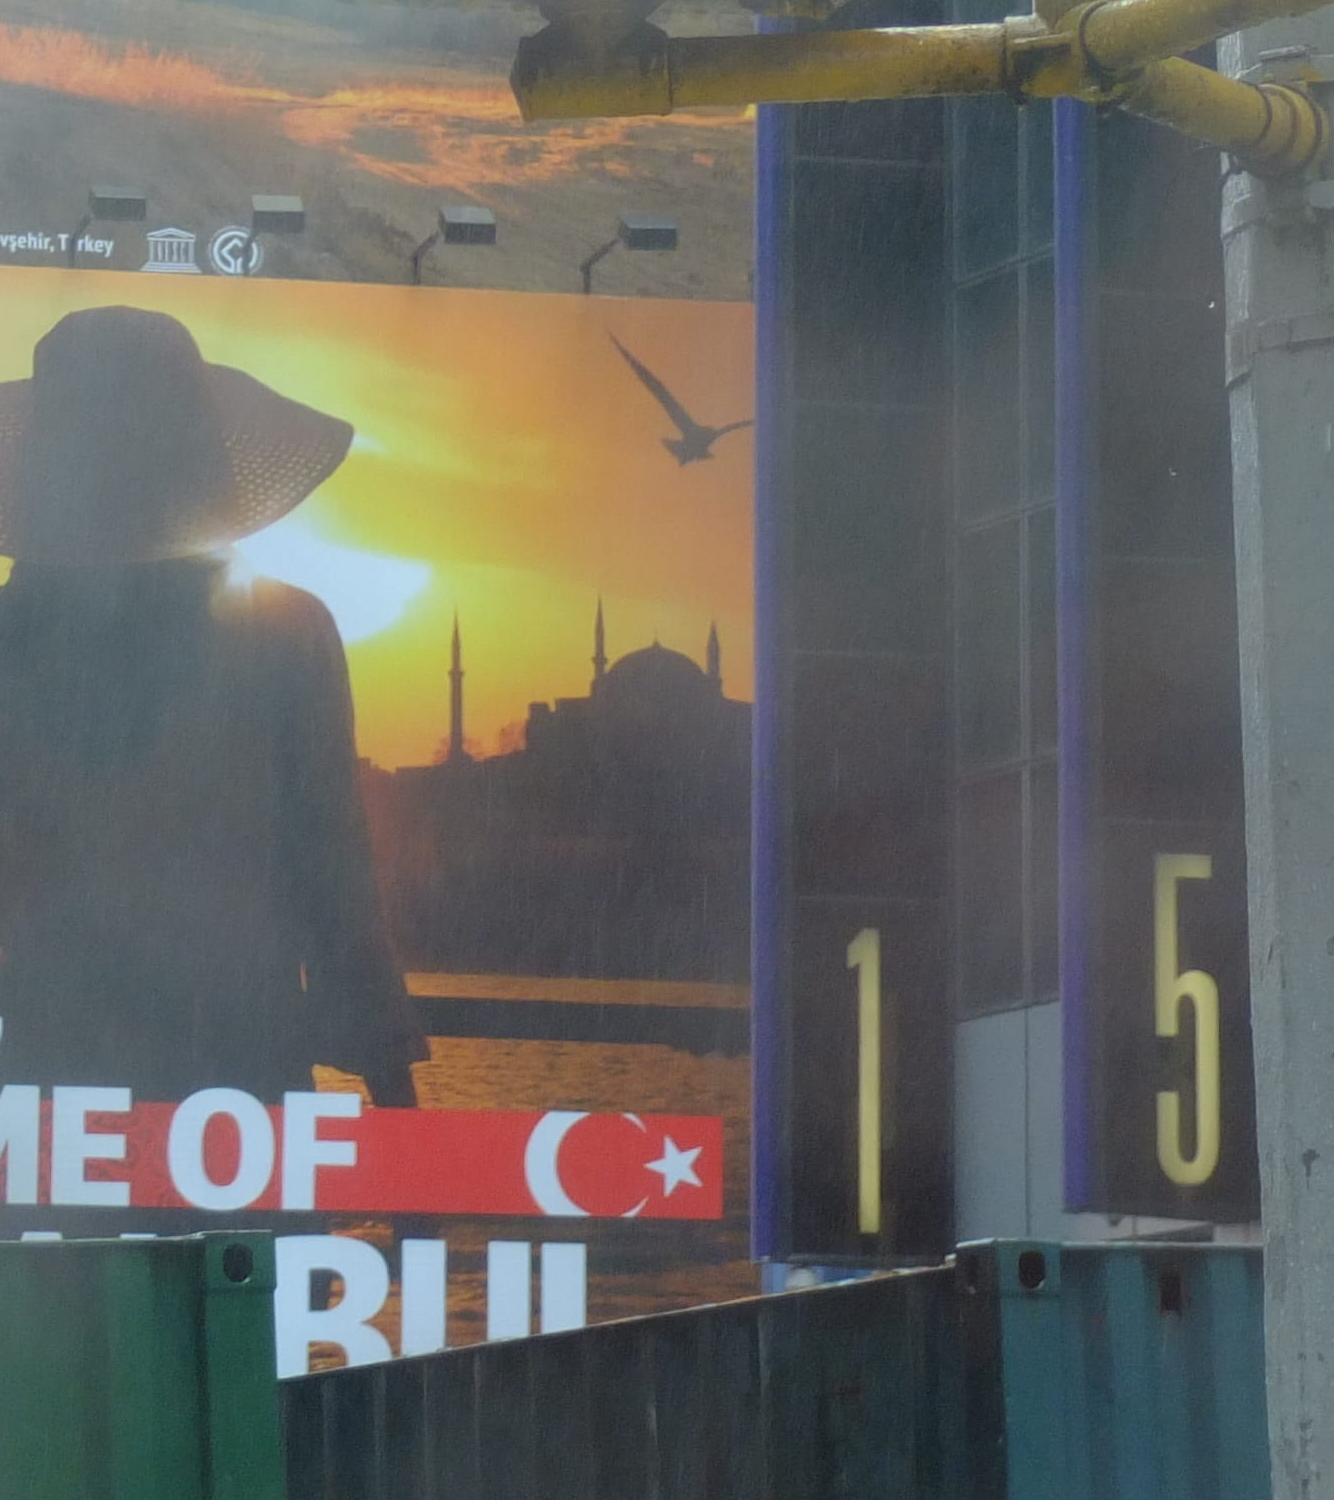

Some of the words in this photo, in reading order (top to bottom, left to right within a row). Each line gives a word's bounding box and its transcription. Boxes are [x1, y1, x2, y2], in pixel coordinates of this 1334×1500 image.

[58, 232, 114, 258] Trkey
[846, 926, 881, 1235] 1
[1153, 853, 1222, 1187] 5
[166, 1084, 363, 1213] OF
